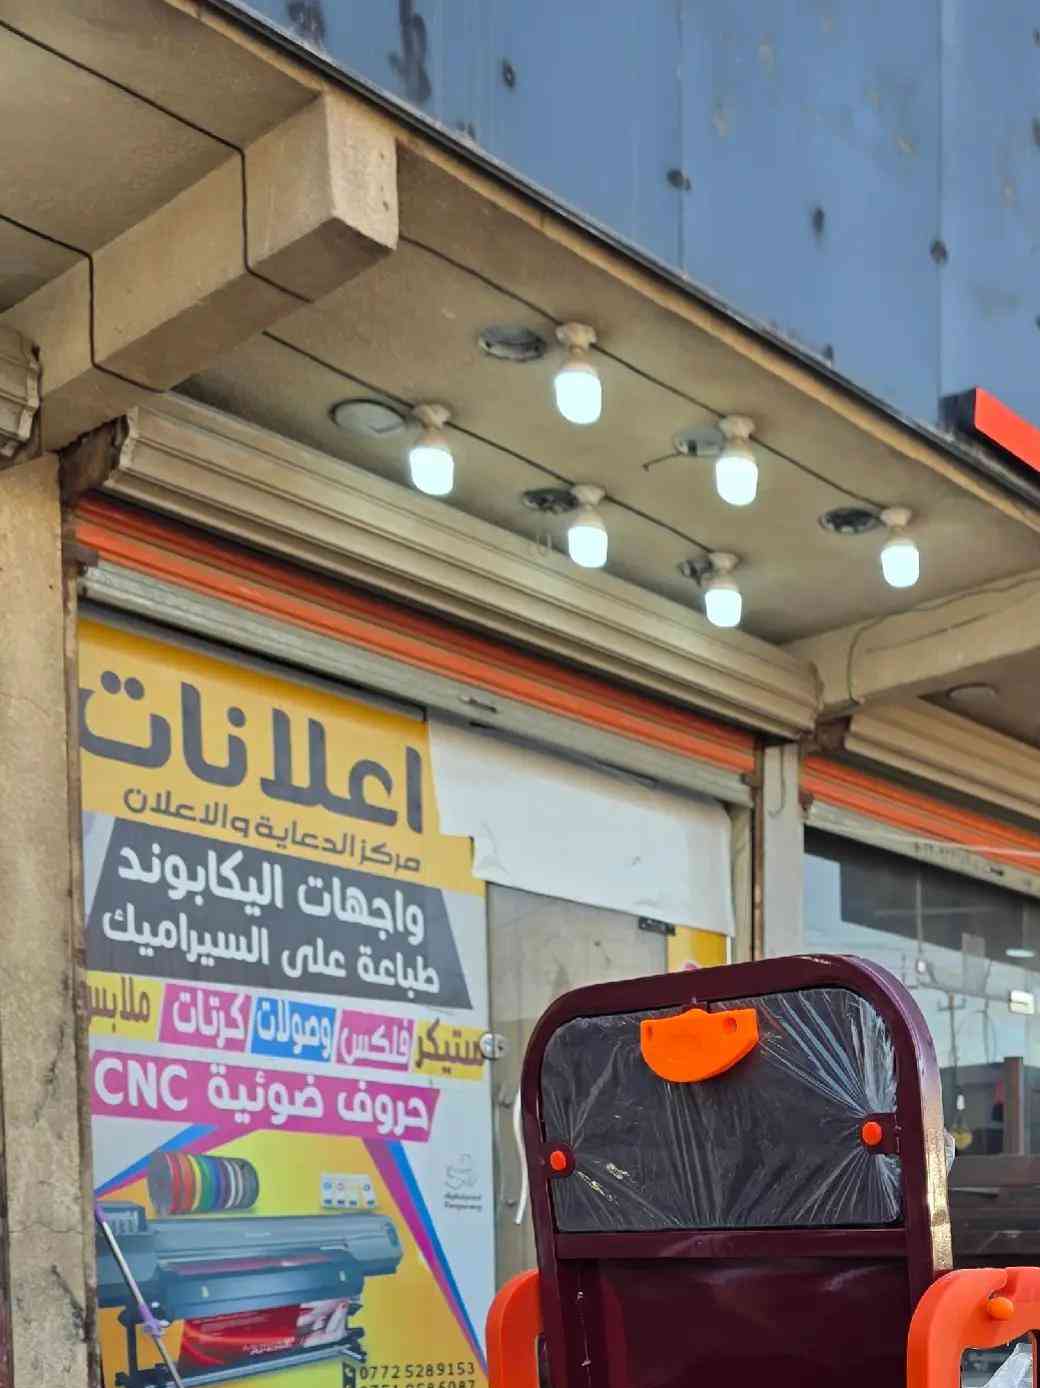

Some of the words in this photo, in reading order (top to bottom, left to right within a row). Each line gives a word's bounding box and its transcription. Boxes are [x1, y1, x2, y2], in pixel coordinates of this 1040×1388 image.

[78, 670, 423, 834] اعلانات
[255, 816, 356, 857] الدعاية
[359, 839, 421, 873] مركز
[118, 842, 284, 917] اليكابوند
[102, 902, 270, 968] السيراميك
[298, 875, 425, 946] واجهات
[281, 937, 347, 978] على
[356, 944, 440, 999] طباعة
[257, 997, 332, 1059] وصولات
[340, 1017, 410, 1065] فلكس
[95, 1057, 188, 1112] CNC
[208, 1063, 325, 1125] ضوئية
[337, 1081, 429, 1137] حروف
[360, 1365, 400, 1380] 0772
[405, 1362, 475, 1378] 5289153
